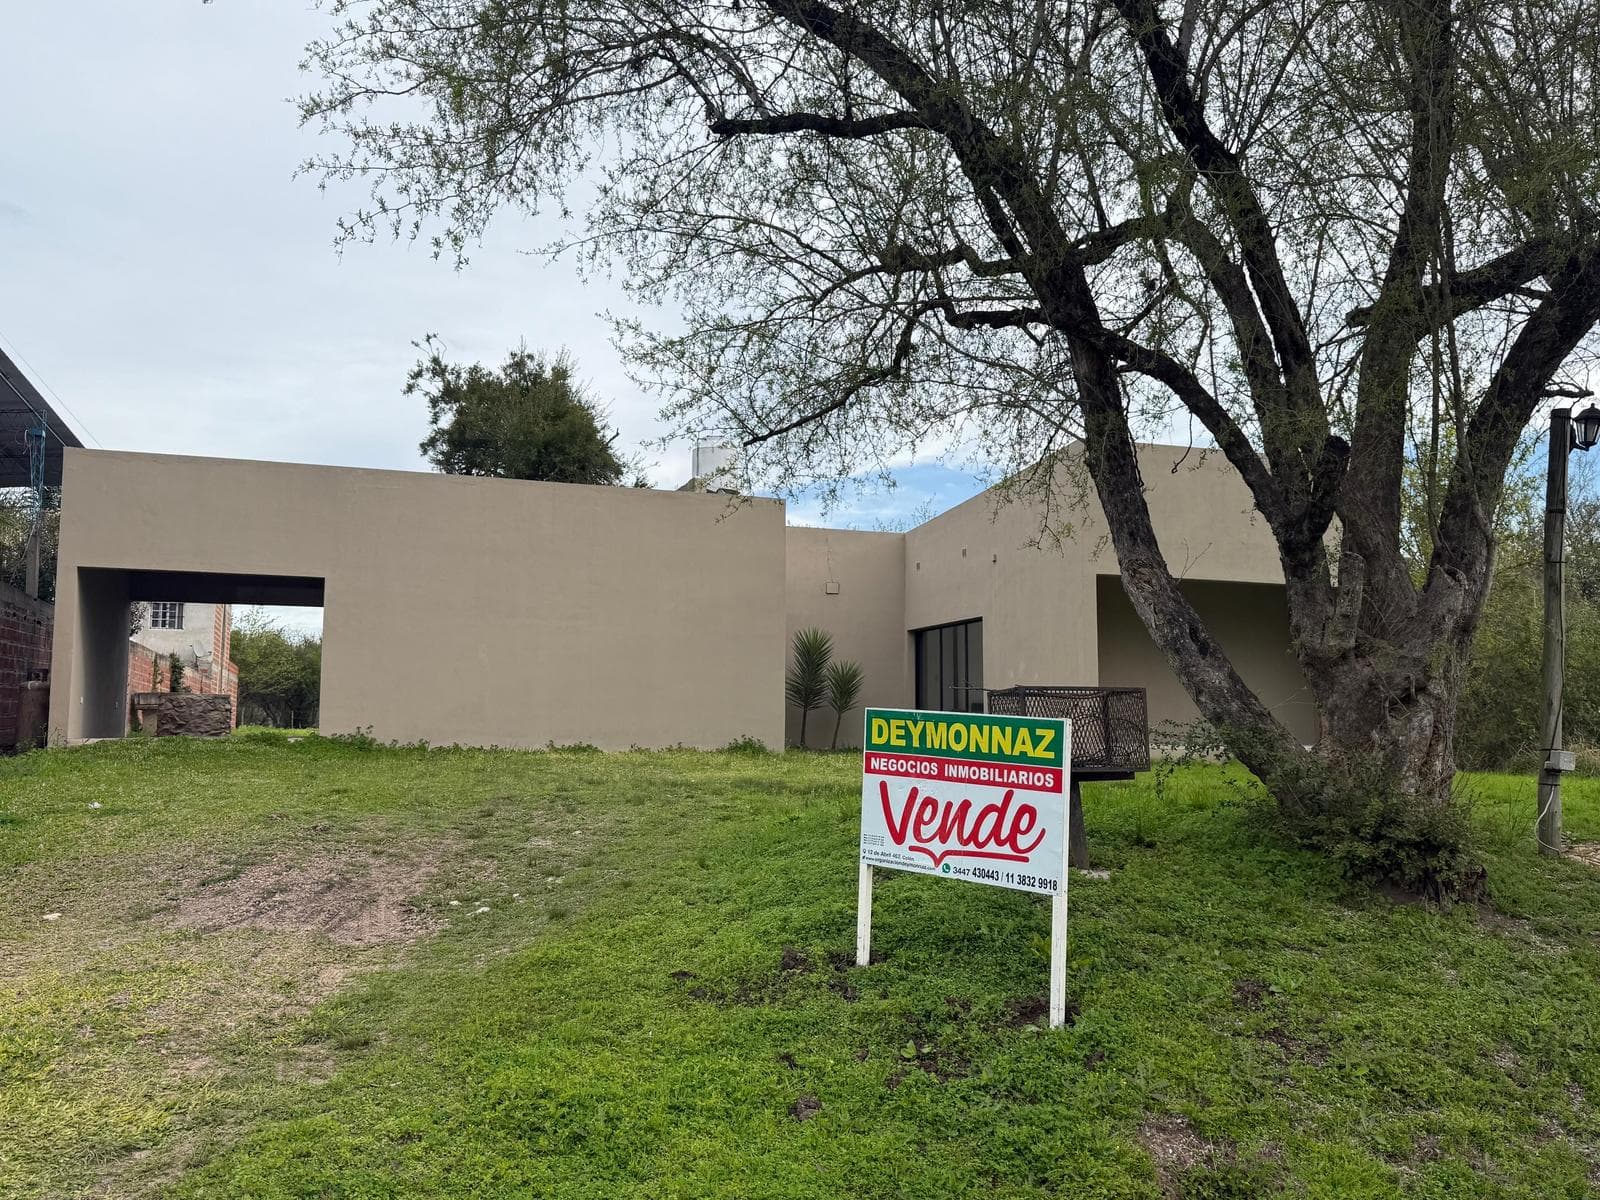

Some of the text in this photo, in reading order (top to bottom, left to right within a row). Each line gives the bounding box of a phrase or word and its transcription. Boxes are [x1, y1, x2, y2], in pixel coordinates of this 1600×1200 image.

[871, 717, 1056, 759] DEYMONNAZ
[870, 756, 1055, 788] NEGOCIOS INMOBILIARIOS
[879, 780, 1047, 855] Vende
[952, 866, 971, 876] 3447
[972, 867, 1000, 881] 430443
[1005, 872, 1015, 884] 11
[1017, 874, 1036, 888] 3832
[1038, 877, 1058, 891] 9918
